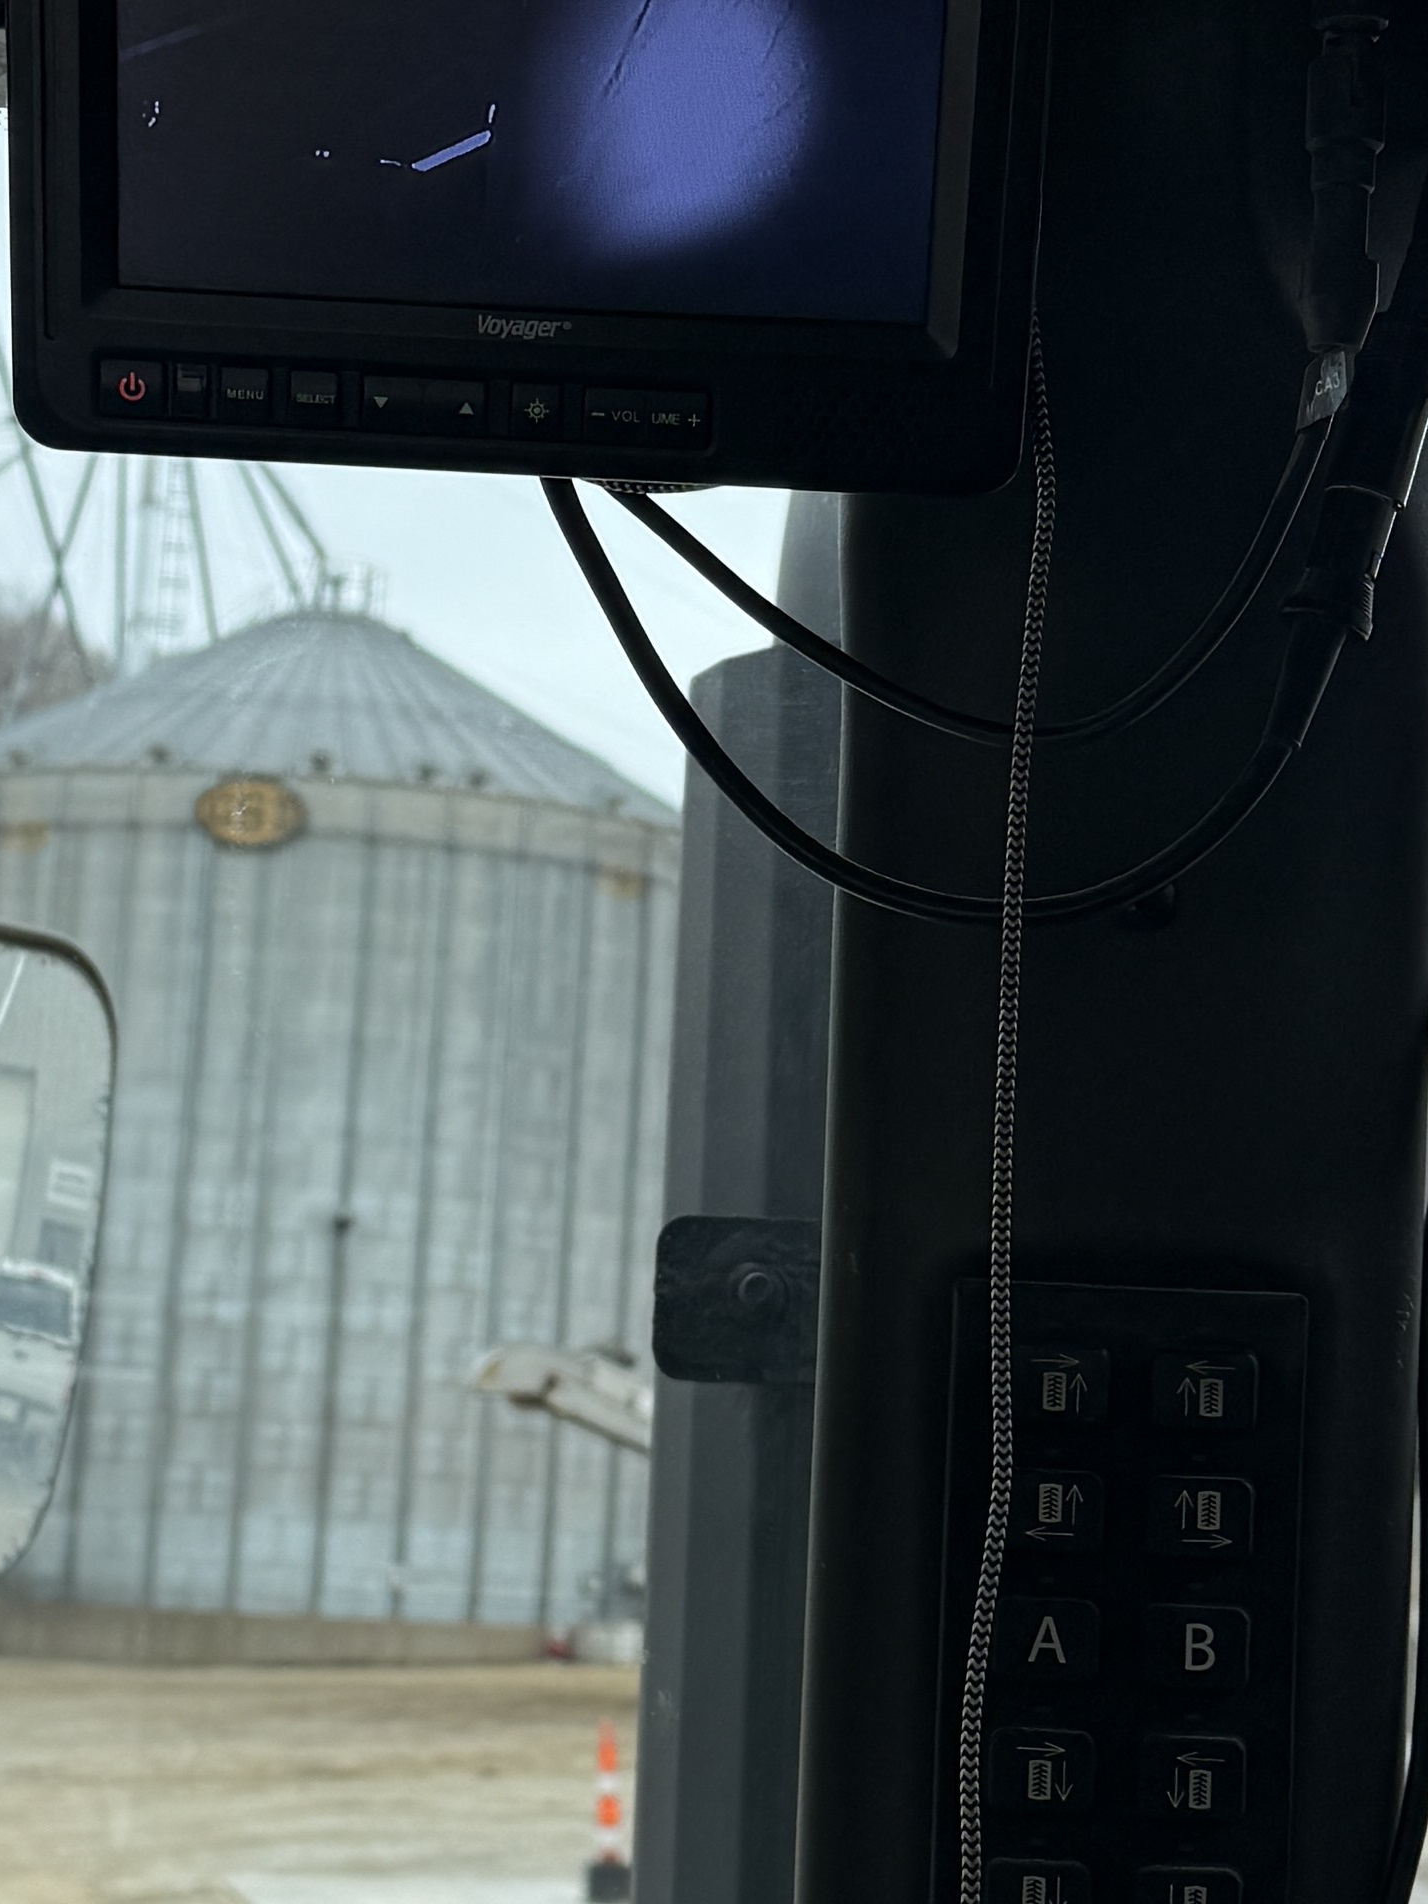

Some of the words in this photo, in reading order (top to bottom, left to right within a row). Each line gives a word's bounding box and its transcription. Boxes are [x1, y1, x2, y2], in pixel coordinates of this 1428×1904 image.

[226, 387, 265, 401] MENU
[295, 392, 336, 405] SELECT
[1027, 1615, 1068, 1665] A
[1183, 1622, 1217, 1673] B
